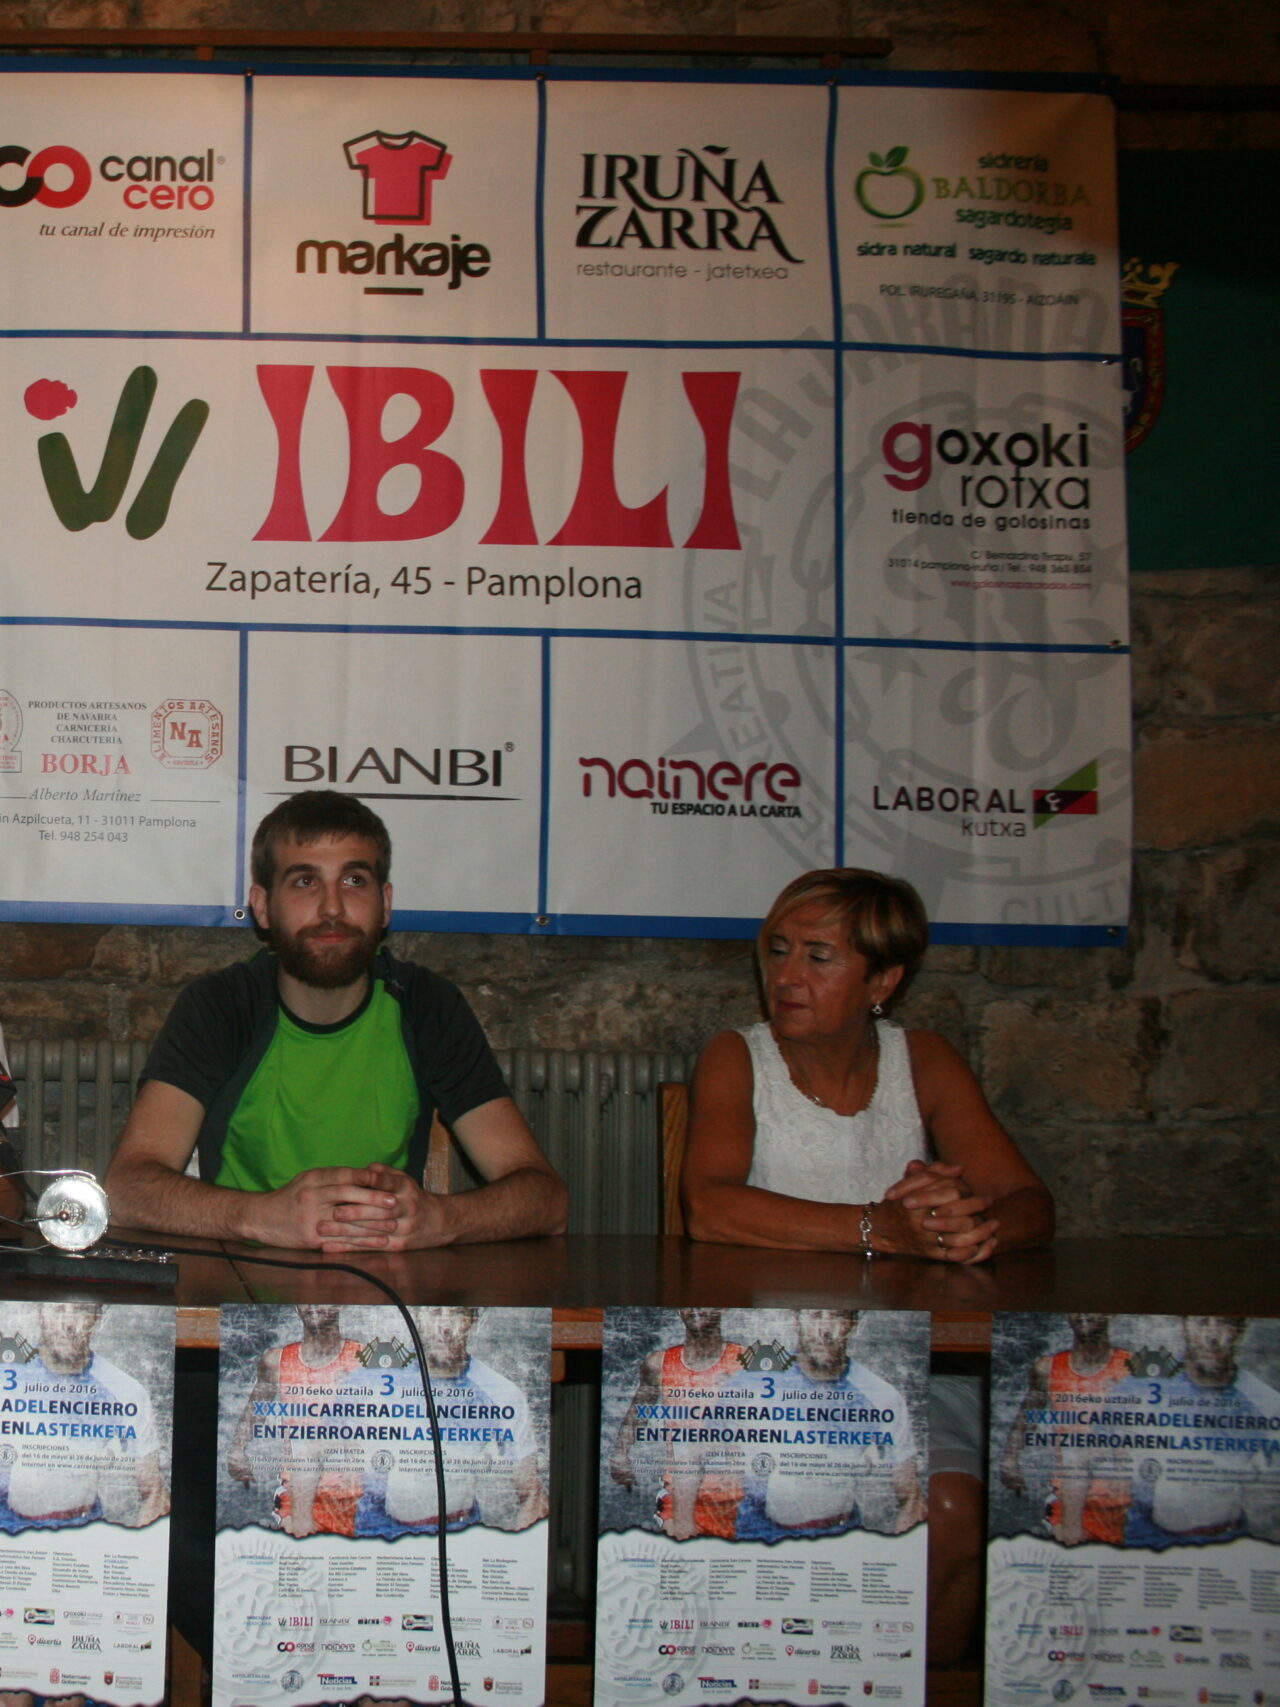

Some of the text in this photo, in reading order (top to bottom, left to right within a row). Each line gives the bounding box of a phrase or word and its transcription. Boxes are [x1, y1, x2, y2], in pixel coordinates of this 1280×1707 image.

[100, 149, 214, 182] canal
[579, 145, 784, 208] IRUÑA
[123, 184, 215, 211] cero
[932, 177, 1091, 206] BALDORBA
[39, 222, 215, 241] tu canal de impresión
[576, 205, 805, 264] ZARRA
[296, 233, 491, 290] markaje
[857, 241, 897, 256] sidra
[903, 242, 957, 258] natural
[968, 247, 1027, 264] sagardo
[576, 262, 789, 281] restaurante jatetxea
[251, 363, 743, 551] IBILI
[882, 421, 1089, 491] goxoki
[892, 509, 1091, 532] tienda de golosinas
[205, 562, 642, 604] Zapatería, 45 Pamplona
[28, 701, 87, 709] PRODUCTOS
[41, 753, 131, 776] BORJA
[284, 745, 502, 787] BIANBI
[579, 757, 801, 802] nainere
[29, 788, 78, 801] Alberto
[873, 785, 1026, 813] LABORAL
[12, 814, 74, 826] Azpilcueta,
[78, 815, 90, 824] 11
[101, 816, 134, 826] 31011
[139, 817, 196, 827] Pamplona
[651, 803, 802, 818] TU ESPACIO A LA CARTA
[38, 830, 128, 842] Tel. 948 254 043
[962, 819, 1026, 837] kutxa
[3, 1369, 17, 1390] 3
[24, 1383, 49, 1393] julio
[53, 1384, 66, 1393] de
[69, 1385, 97, 1394] 2016
[286, 1386, 333, 1395] 2016eko
[336, 1386, 373, 1396] uztaila
[380, 1374, 395, 1395] 3
[432, 1388, 443, 1397] de
[447, 1389, 474, 1398] 2016
[668, 1377, 854, 1401] 2016eko uztaila 3 julio de 2016
[1147, 1383, 1161, 1405] 3
[289, 1617, 313, 1626] IBILI
[671, 1620, 694, 1629] IBILI
